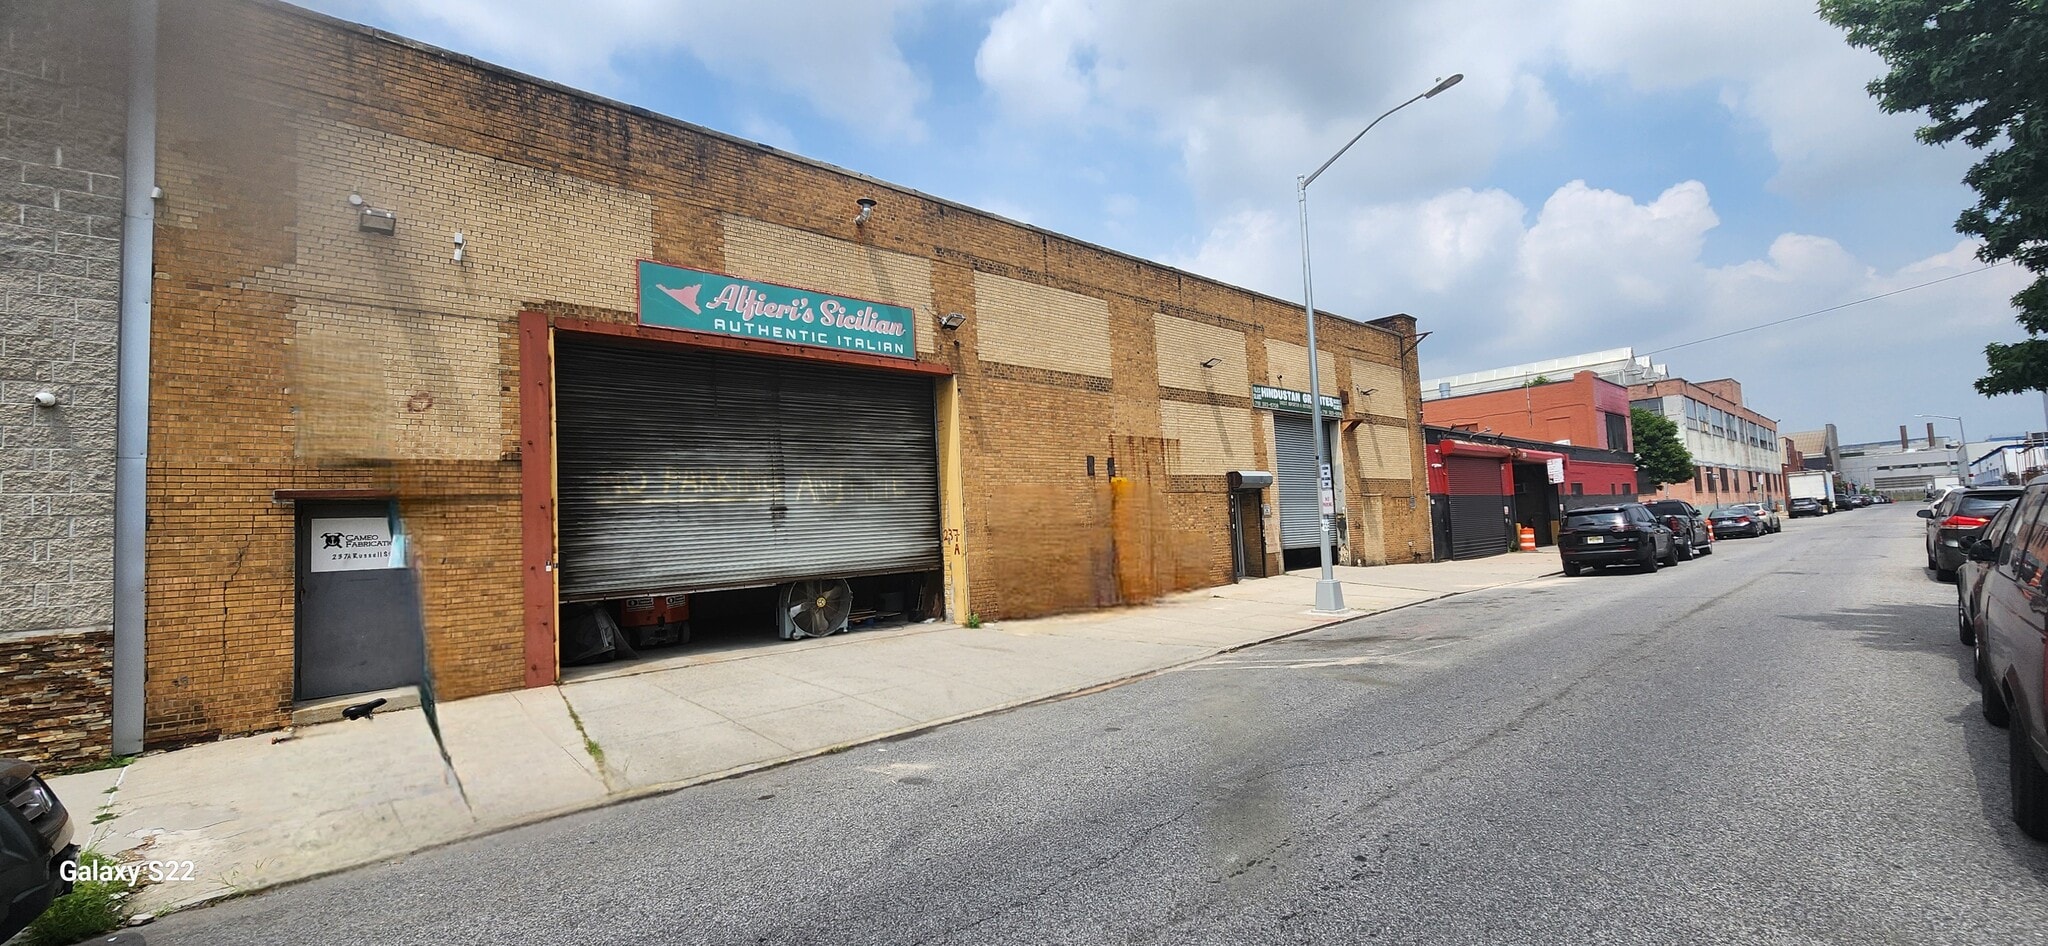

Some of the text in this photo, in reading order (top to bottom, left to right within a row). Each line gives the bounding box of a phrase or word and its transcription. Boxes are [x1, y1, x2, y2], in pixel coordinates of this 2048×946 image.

[706, 284, 906, 337] Alfieri's Sicilian
[714, 319, 904, 354] AUTHENTIC ITALIAN
[1261, 387, 1300, 402] HINDUSTAN
[1302, 393, 1333, 408] GRITES
[943, 529, 960, 542] 237
[954, 544, 960, 555] A
